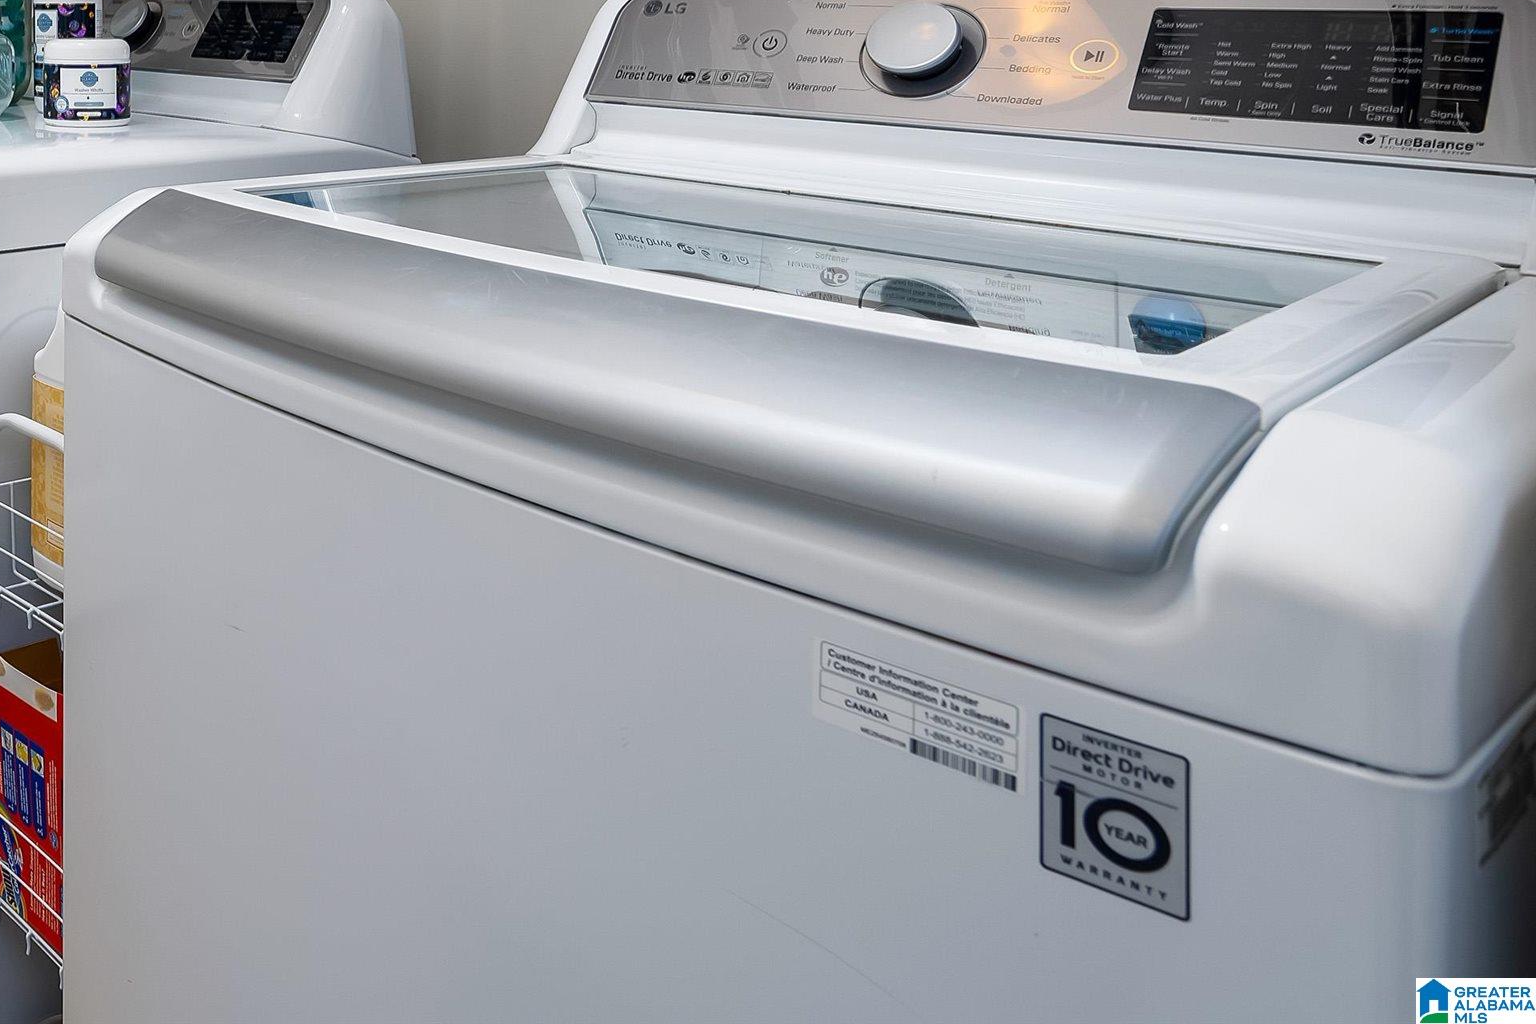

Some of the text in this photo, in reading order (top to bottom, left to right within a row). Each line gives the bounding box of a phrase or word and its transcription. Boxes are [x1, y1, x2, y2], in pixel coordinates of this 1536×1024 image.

[664, 2, 688, 15] LG
[815, 1, 847, 10] Normal
[1032, 5, 1071, 14] Normal
[806, 27, 855, 37] Heavy Duty
[1012, 33, 1061, 43] Delicates
[1270, 42, 1293, 50] Extra
[1324, 44, 1352, 52] Heavy
[796, 54, 844, 64] Deep Wash
[1432, 54, 1484, 64] Tub Clean
[615, 68, 673, 82] Direct Drive
[1008, 64, 1052, 75] Bedding
[1141, 67, 1192, 75] Delay Wash
[1371, 66, 1422, 74] Speed Wash
[1369, 76, 1410, 85] Stain Care
[787, 82, 837, 93] Waterproof
[1316, 83, 1338, 92] Light
[1422, 81, 1482, 92] Extra Rinse
[977, 93, 1043, 106] Downloaded
[1136, 93, 1183, 103] Water Plus
[1253, 100, 1279, 110] Spin
[1311, 104, 1333, 114] Soil
[1360, 102, 1404, 114] Special
[1366, 113, 1394, 123] Care
[1430, 110, 1464, 119] Signal
[1423, 118, 1451, 126] Control
[815, 251, 850, 263] Softener
[985, 277, 1031, 291] Detergent
[828, 648, 979, 707] Customer Information Center
[833, 661, 866, 679] Centre
[868, 675, 938, 705] d'information
[950, 702, 960, 712] la
[856, 686, 878, 702] USA
[845, 699, 889, 722] CANADA
[1082, 733, 1143, 760] INVERTER
[1051, 735, 1176, 789] Direct Drive
[1081, 763, 1144, 791] MOTOR
[1054, 780, 1172, 873] 10
[1104, 822, 1148, 850] YEAR
[1059, 852, 1168, 901] WARRANTY
